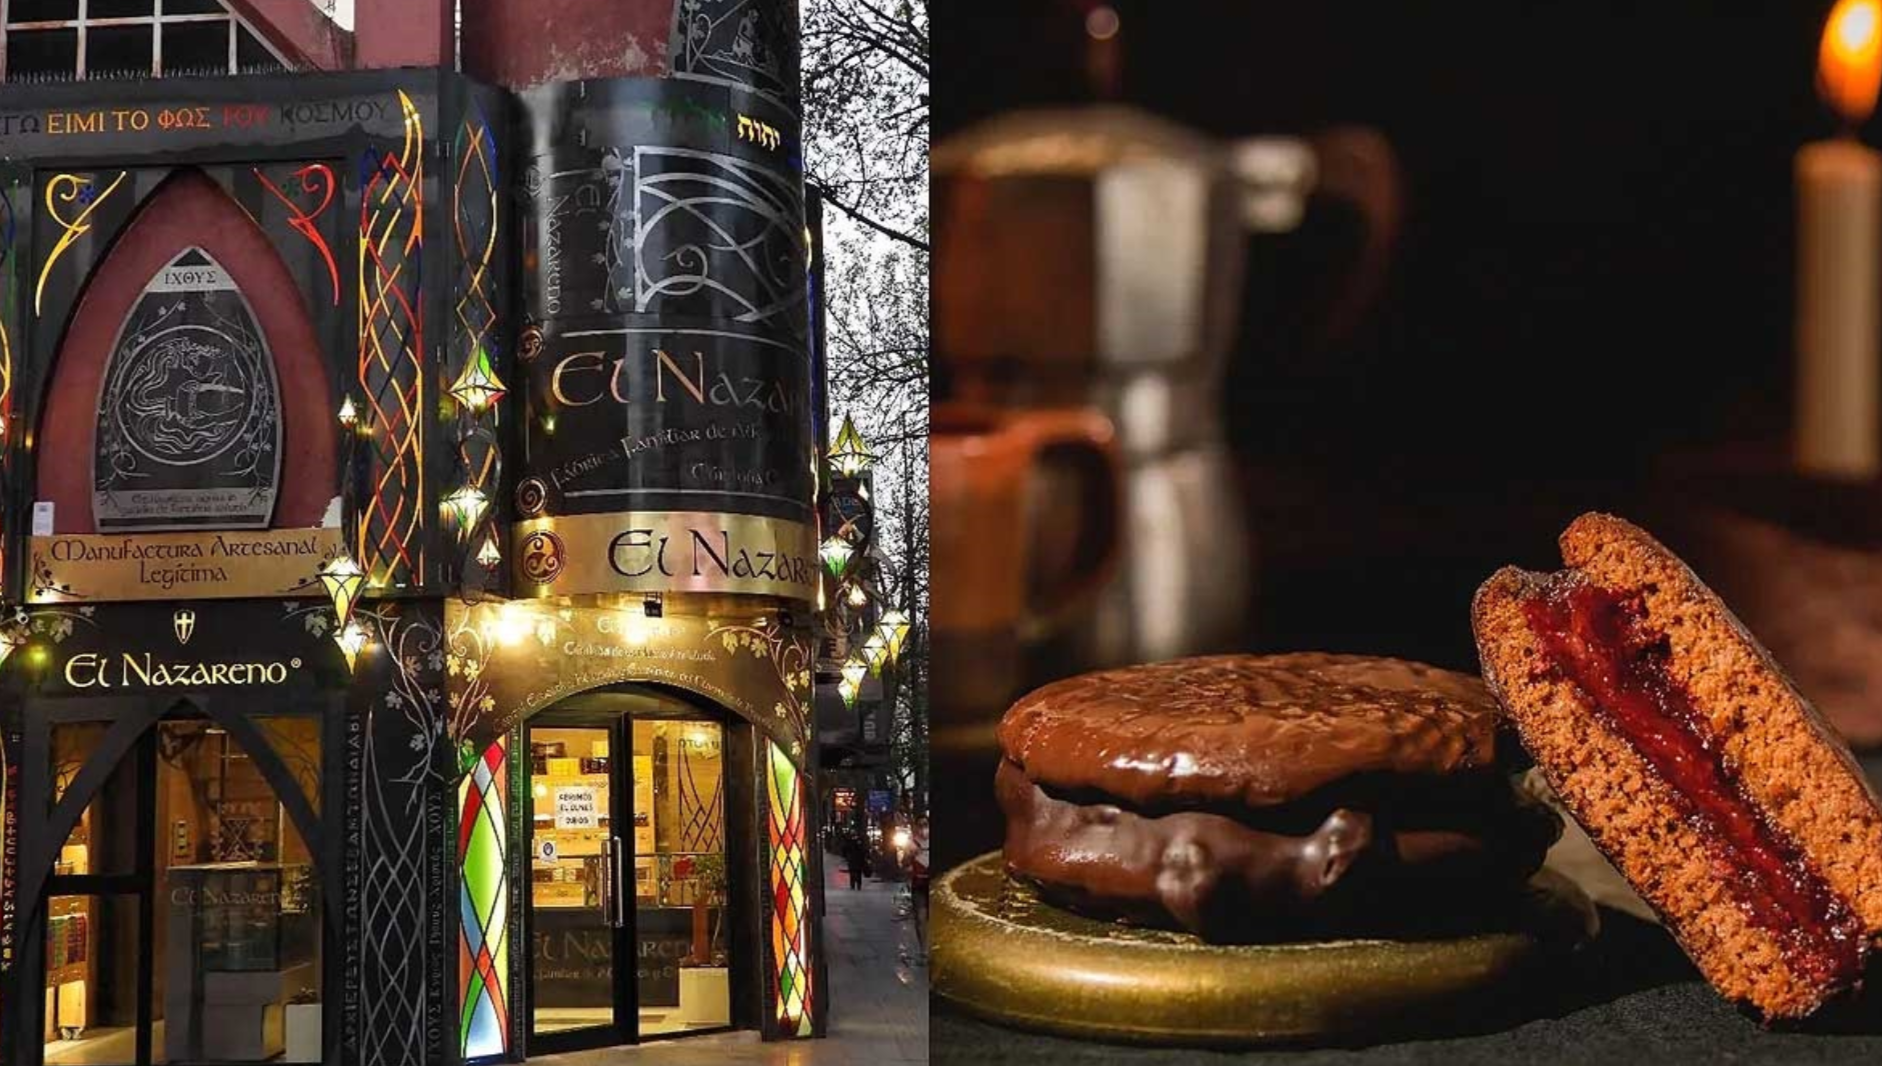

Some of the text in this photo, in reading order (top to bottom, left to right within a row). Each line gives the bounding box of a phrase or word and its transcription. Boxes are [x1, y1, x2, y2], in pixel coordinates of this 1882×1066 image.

[0, 114, 40, 135] ΓΩ
[111, 110, 149, 131] ΤΟ
[157, 107, 211, 128] ΦΩΣ
[552, 350, 631, 406] El
[51, 535, 317, 561] Manufactura Artesanal
[607, 529, 673, 577] El
[65, 653, 111, 688] El
